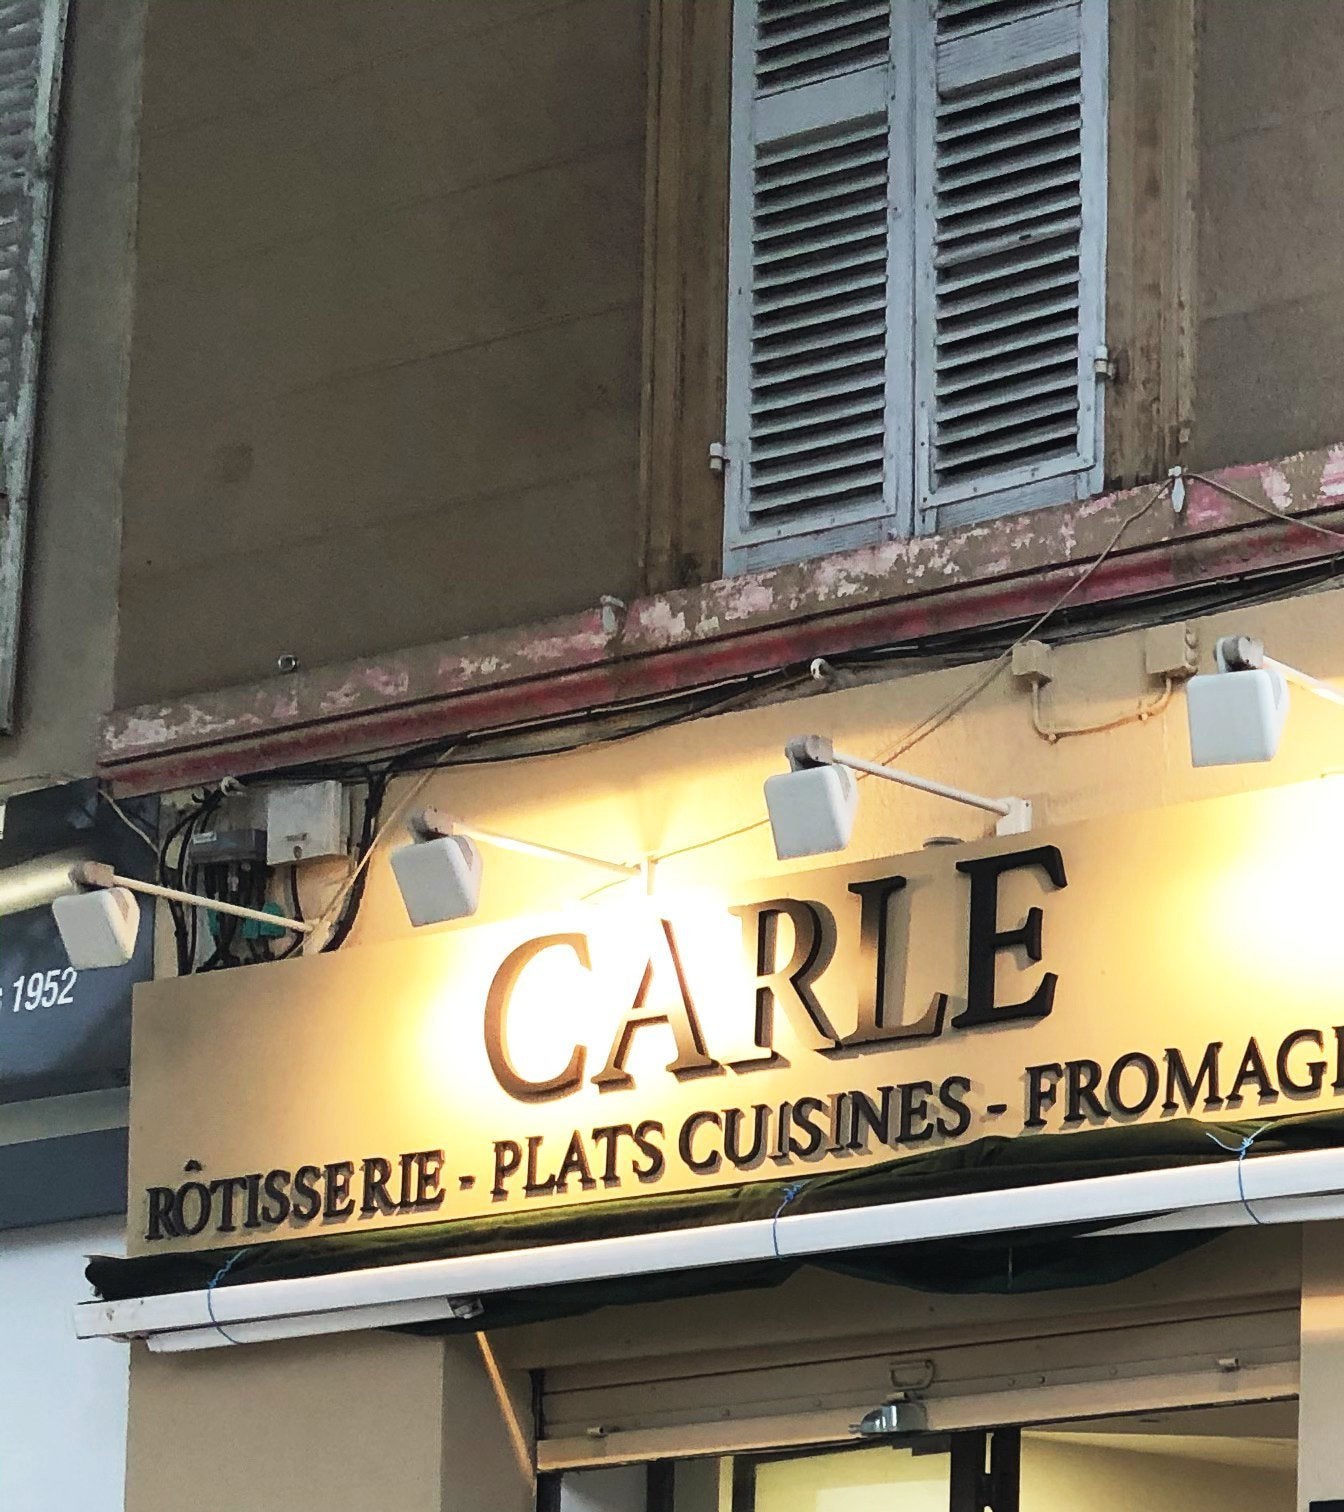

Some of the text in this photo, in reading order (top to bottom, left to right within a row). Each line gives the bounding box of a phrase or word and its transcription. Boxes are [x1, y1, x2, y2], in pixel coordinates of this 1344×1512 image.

[13, 966, 78, 1013] 1952
[482, 842, 1070, 1106] CARLE
[145, 1148, 448, 1242] RÔTISSERIE
[488, 1119, 668, 1201] PLATS
[678, 1074, 974, 1172] CUISINES
